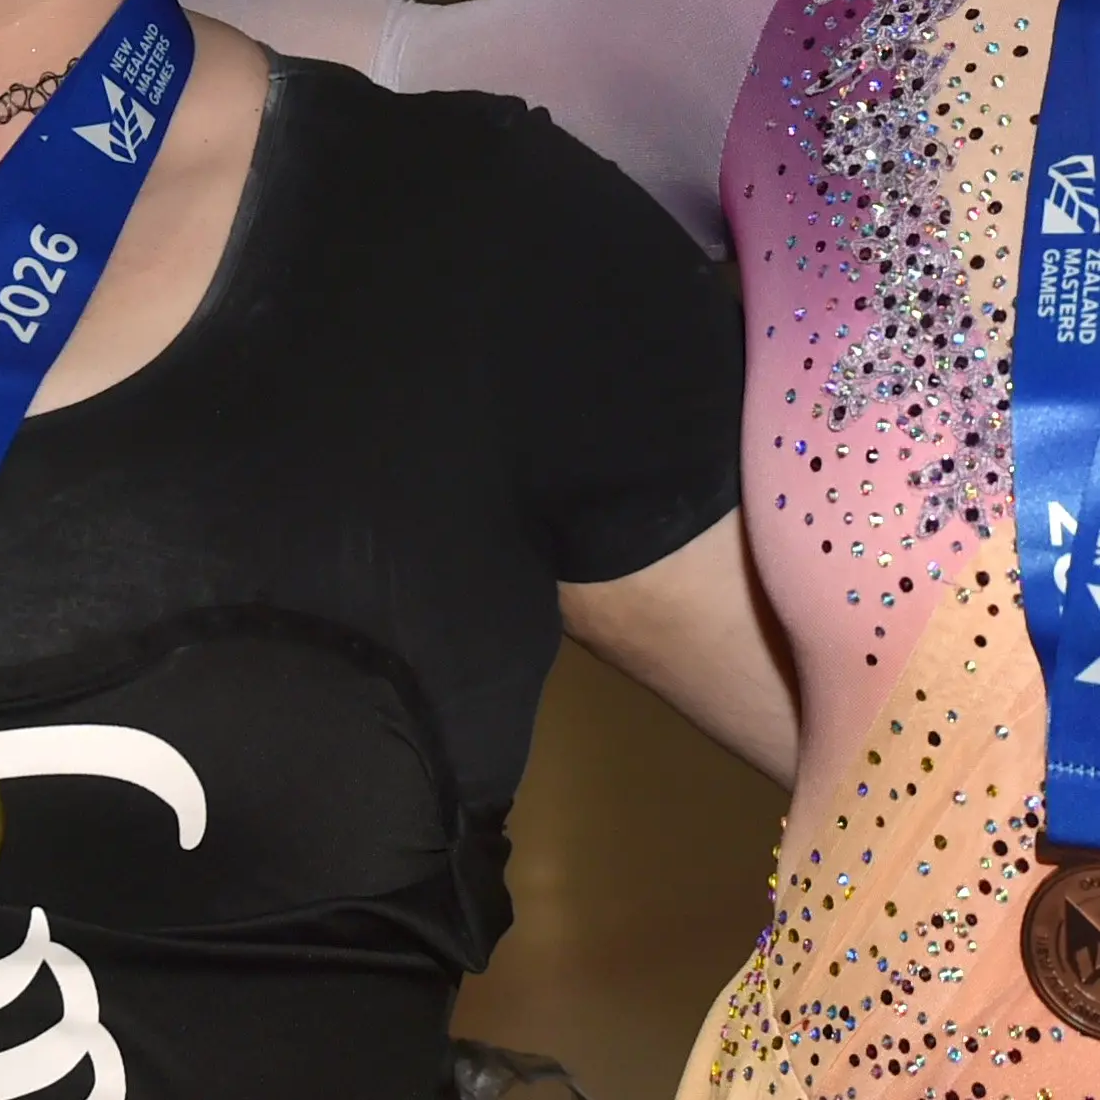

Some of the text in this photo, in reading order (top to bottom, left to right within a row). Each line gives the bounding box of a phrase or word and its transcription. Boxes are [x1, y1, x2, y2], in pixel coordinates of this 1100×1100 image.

[109, 37, 133, 74] NEW
[122, 23, 159, 85] ZEALAND
[135, 34, 171, 97] MASTERS
[149, 60, 176, 106] GAMES
[1037, 248, 1061, 318] GAMES
[1056, 248, 1083, 343] MASTERS
[1078, 248, 1100, 344] ZEALAND
